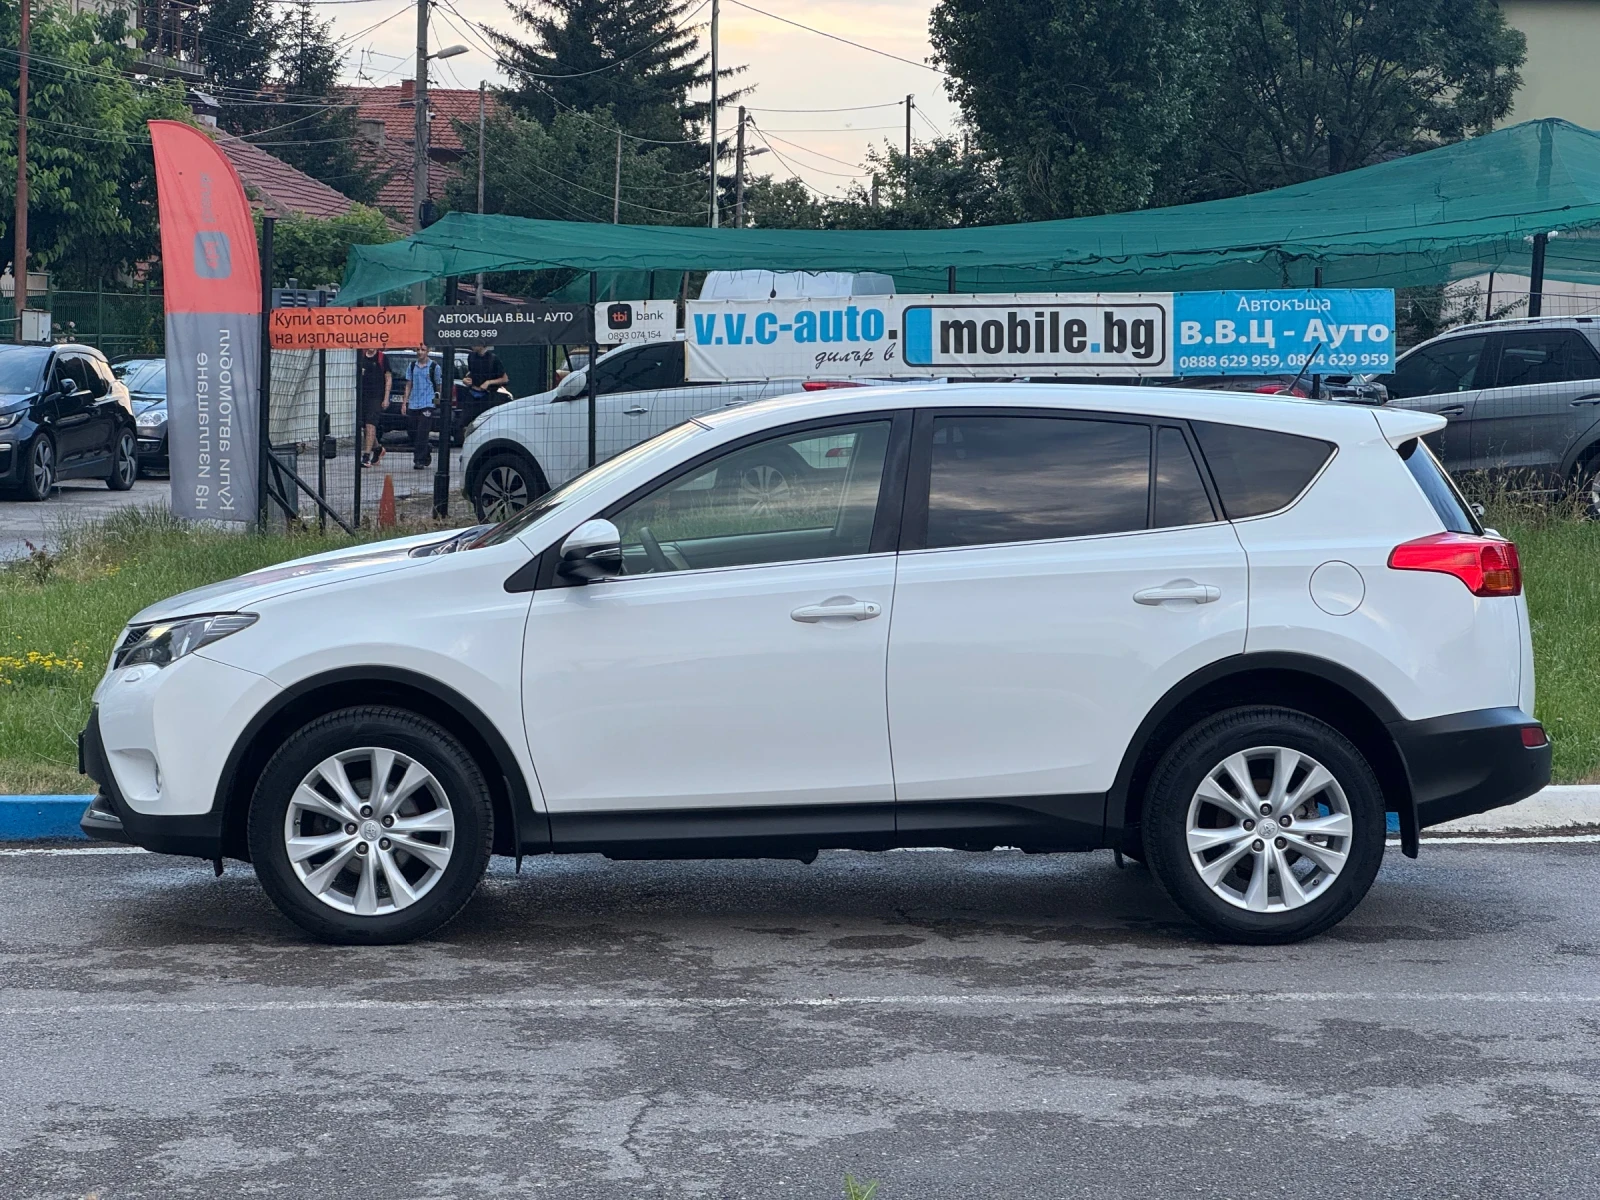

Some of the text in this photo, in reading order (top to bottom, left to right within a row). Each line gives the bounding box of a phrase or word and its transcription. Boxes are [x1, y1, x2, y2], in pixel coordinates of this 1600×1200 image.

[1237, 296, 1331, 313] Автокъща
[275, 312, 406, 328] Купи автомобил
[438, 313, 503, 324] АВТОКЪЩА
[505, 312, 535, 324] В.В.Ц
[544, 312, 573, 322] АУТО
[612, 310, 664, 322] tbi bank
[275, 332, 389, 344] на изплащане
[438, 329, 497, 338] 0888 629 959
[608, 331, 661, 340] 0893 074 154
[940, 311, 1155, 359] mobile.bg
[1180, 319, 1276, 349] В.В.Ц
[1303, 318, 1389, 350] Ауто
[815, 347, 874, 369] дилър
[1179, 355, 1217, 368] 0888
[1219, 355, 1248, 367] 629
[1251, 354, 1284, 368] 959,
[1328, 353, 1357, 366] 629
[1360, 353, 1389, 366] 959
